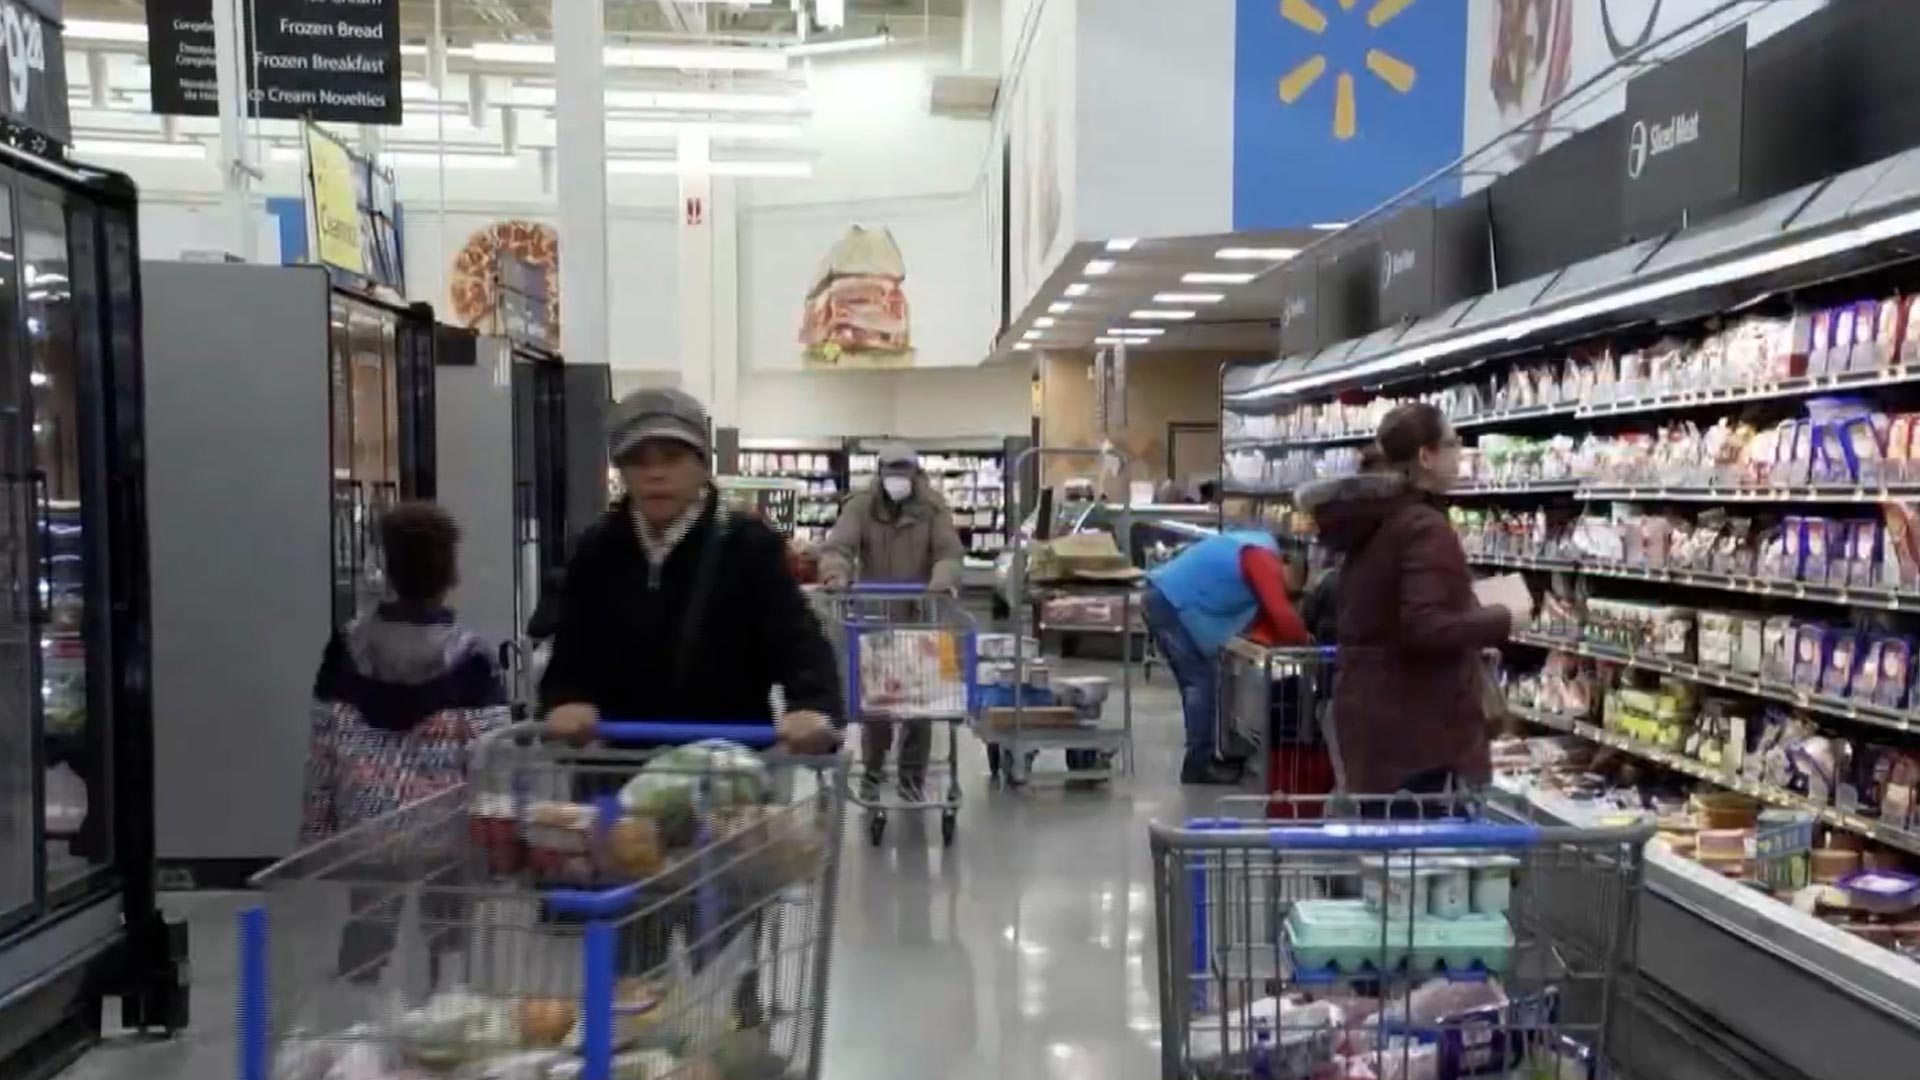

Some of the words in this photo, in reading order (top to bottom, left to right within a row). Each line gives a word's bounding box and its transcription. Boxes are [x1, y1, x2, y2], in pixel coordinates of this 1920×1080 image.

[280, 18, 334, 36] Frozen
[337, 21, 384, 39] Bread
[253, 51, 308, 69] Frozen
[312, 53, 385, 74] Breakfast
[247, 88, 265, 102] ce
[268, 87, 317, 104] Cream
[319, 89, 386, 108] Novelties
[1676, 109, 1699, 145] Meat
